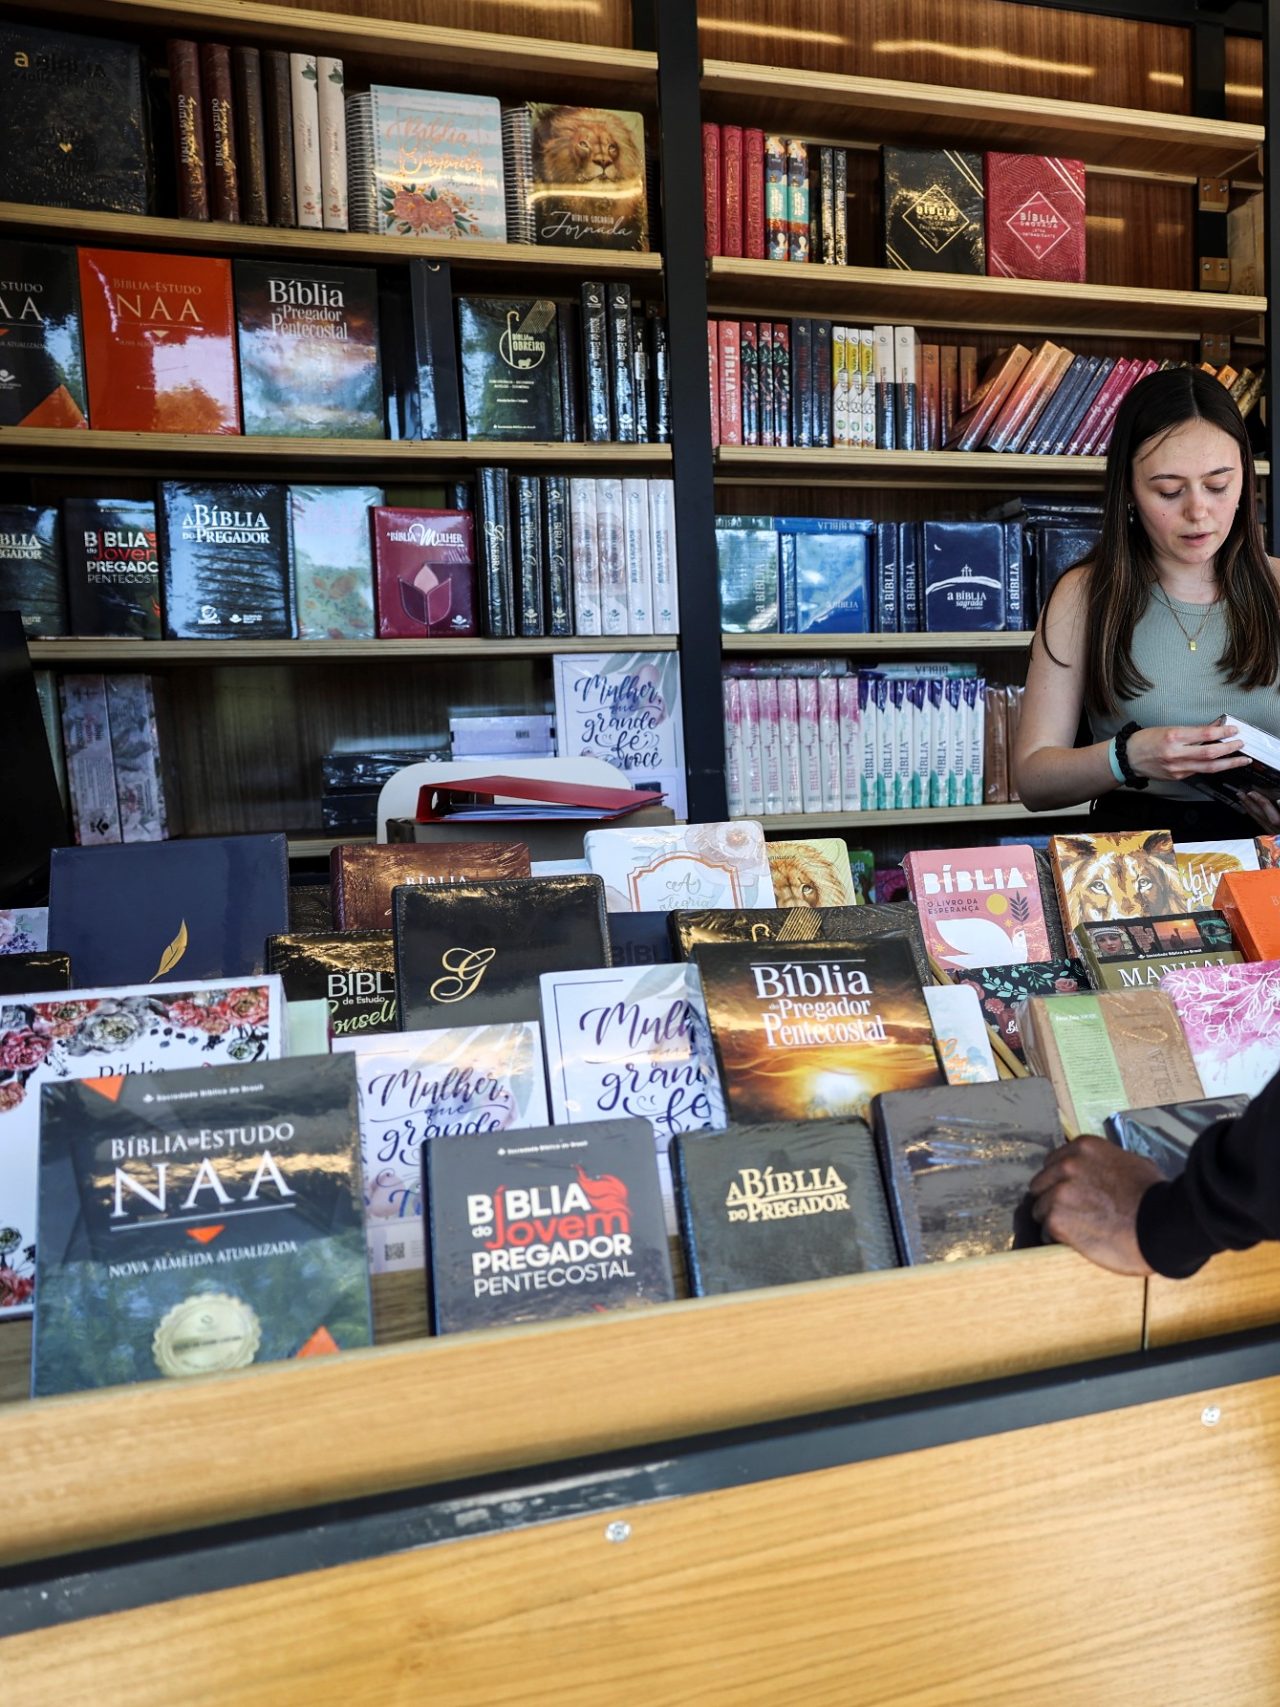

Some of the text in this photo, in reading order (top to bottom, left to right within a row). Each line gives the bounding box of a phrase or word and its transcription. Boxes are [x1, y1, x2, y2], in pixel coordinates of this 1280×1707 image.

[541, 210, 633, 239] Jornada
[1020, 210, 1058, 224] BÍBLIA
[0, 280, 43, 293] STUDO
[155, 281, 202, 294] ESTUDO
[268, 279, 345, 307] Bíblia
[116, 294, 202, 322] NAA
[282, 305, 343, 323] Pregador
[271, 313, 348, 340] Pentecostal
[182, 503, 269, 527] A BÍBLIA
[0, 532, 42, 547] BLIA
[195, 528, 270, 544] PREGADOR
[390, 530, 416, 543] BÍBLIA
[86, 561, 159, 573] PREGADO
[87, 574, 158, 584] PENTECOST
[904, 562, 915, 601] BÍBLIA
[882, 562, 895, 612] a BÍBLIA
[946, 590, 987, 601] a BÍBLIA
[1008, 562, 1020, 610] a BÍBLIA
[581, 711, 659, 743] grande
[624, 747, 663, 771] você
[865, 742, 874, 779] BÍBLIA
[883, 742, 892, 779] BÍBLIA
[900, 741, 909, 778] BÍBLIA
[919, 741, 928, 777] BÍBLIA
[937, 740, 947, 776] BÍBLIA
[955, 740, 964, 776] BÍBLIA
[971, 740, 981, 775] BÍBLIA
[922, 864, 1029, 895] BÍBLIA
[928, 904, 980, 915] ESPERANÇA
[936, 898, 964, 908] LIVRO
[966, 897, 979, 905] DA
[328, 970, 396, 998] BÍBL
[750, 963, 874, 999] Bíblia
[342, 995, 386, 1006] de Estudo
[778, 997, 872, 1022] Pregador
[328, 999, 397, 1035] onselh
[761, 1012, 888, 1047] Pentecostal
[156, 1091, 199, 1103] Sociedade
[200, 1087, 228, 1098] Bíblica
[241, 1082, 264, 1093] Brasil
[368, 1067, 510, 1108] Mulher,
[111, 1134, 188, 1160] BÍBLIA
[199, 1122, 295, 1150] ESTUDO
[377, 1111, 503, 1162] grande
[110, 1149, 297, 1219] NAA
[727, 1166, 846, 1201] A BÍBLIA
[747, 1193, 851, 1223] PREGADOR
[472, 1225, 493, 1239] do
[108, 1240, 298, 1279] NOVA ALMEIDA ATUALIZADA
[472, 1233, 633, 1276] PREGADOR
[474, 1259, 636, 1299] PENTECOSTAL
